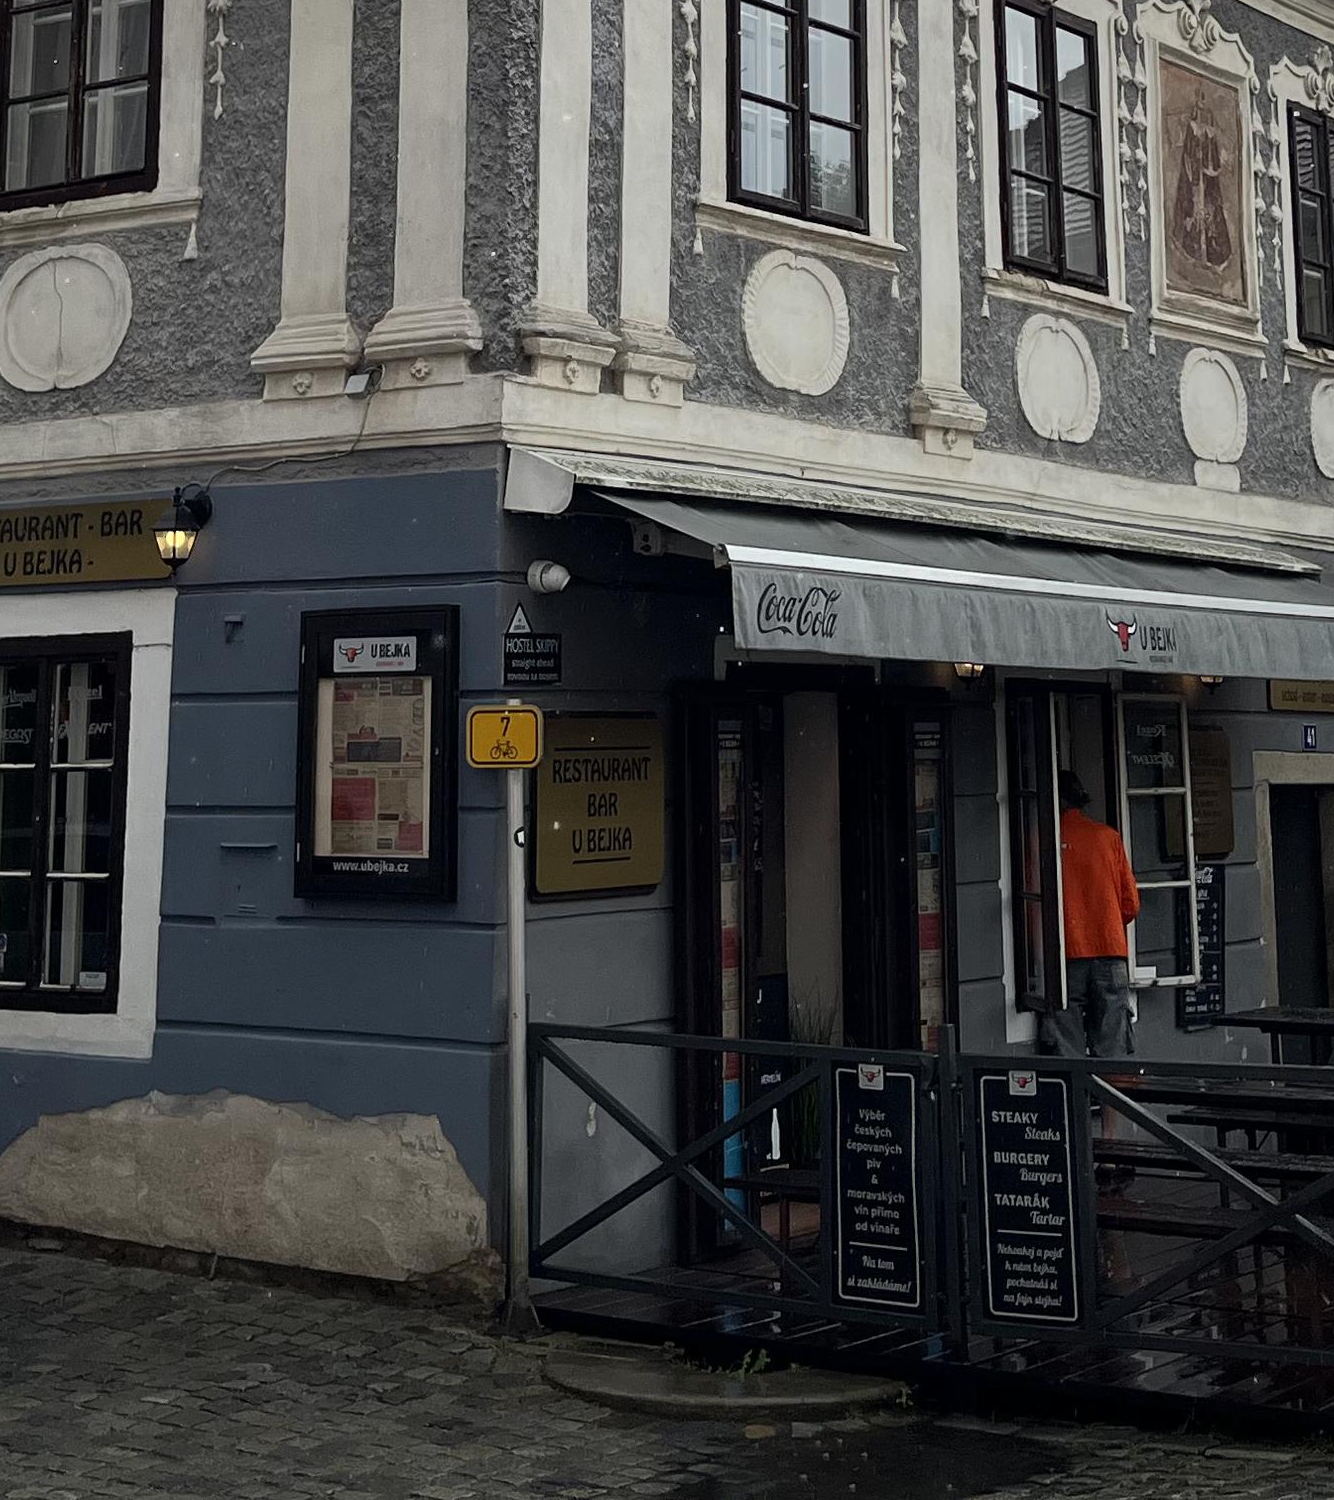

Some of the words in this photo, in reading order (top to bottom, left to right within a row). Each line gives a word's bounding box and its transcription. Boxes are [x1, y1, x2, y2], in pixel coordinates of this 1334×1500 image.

[100, 508, 143, 538] BAR
[3, 552, 17, 577] U
[23, 549, 82, 576] BEJKA
[757, 582, 842, 638] Coca-Cola
[506, 638, 535, 653] HOSTEL
[536, 637, 559, 653] SKIPPY
[1139, 625, 1147, 650] U
[371, 643, 378, 658] U
[379, 643, 410, 658] BEJKA
[511, 658, 536, 670] straight
[500, 716, 510, 737] 7
[1307, 727, 1315, 746] 41
[553, 756, 651, 783] RESTAURANT
[587, 792, 617, 817] BAR
[572, 829, 582, 853] U
[587, 827, 632, 852] BEJKA
[332, 860, 409, 875] www.ubejka.cz
[859, 1108, 886, 1122] Výběr
[991, 1110, 1038, 1124] STEAKY
[854, 1124, 892, 1139] českých
[1025, 1126, 1060, 1141] Steaks
[846, 1138, 903, 1156] čepovaných
[867, 1157, 881, 1170] piv
[993, 1151, 1050, 1166] BURGERY
[1019, 1167, 1063, 1186] Burgers
[847, 1189, 905, 1204] moravských
[994, 1192, 1050, 1209] TATARÁK
[1030, 1210, 1066, 1226] Tartar
[855, 1221, 867, 1231] od
[870, 1222, 900, 1235] vinaře
[862, 1255, 876, 1268] Na
